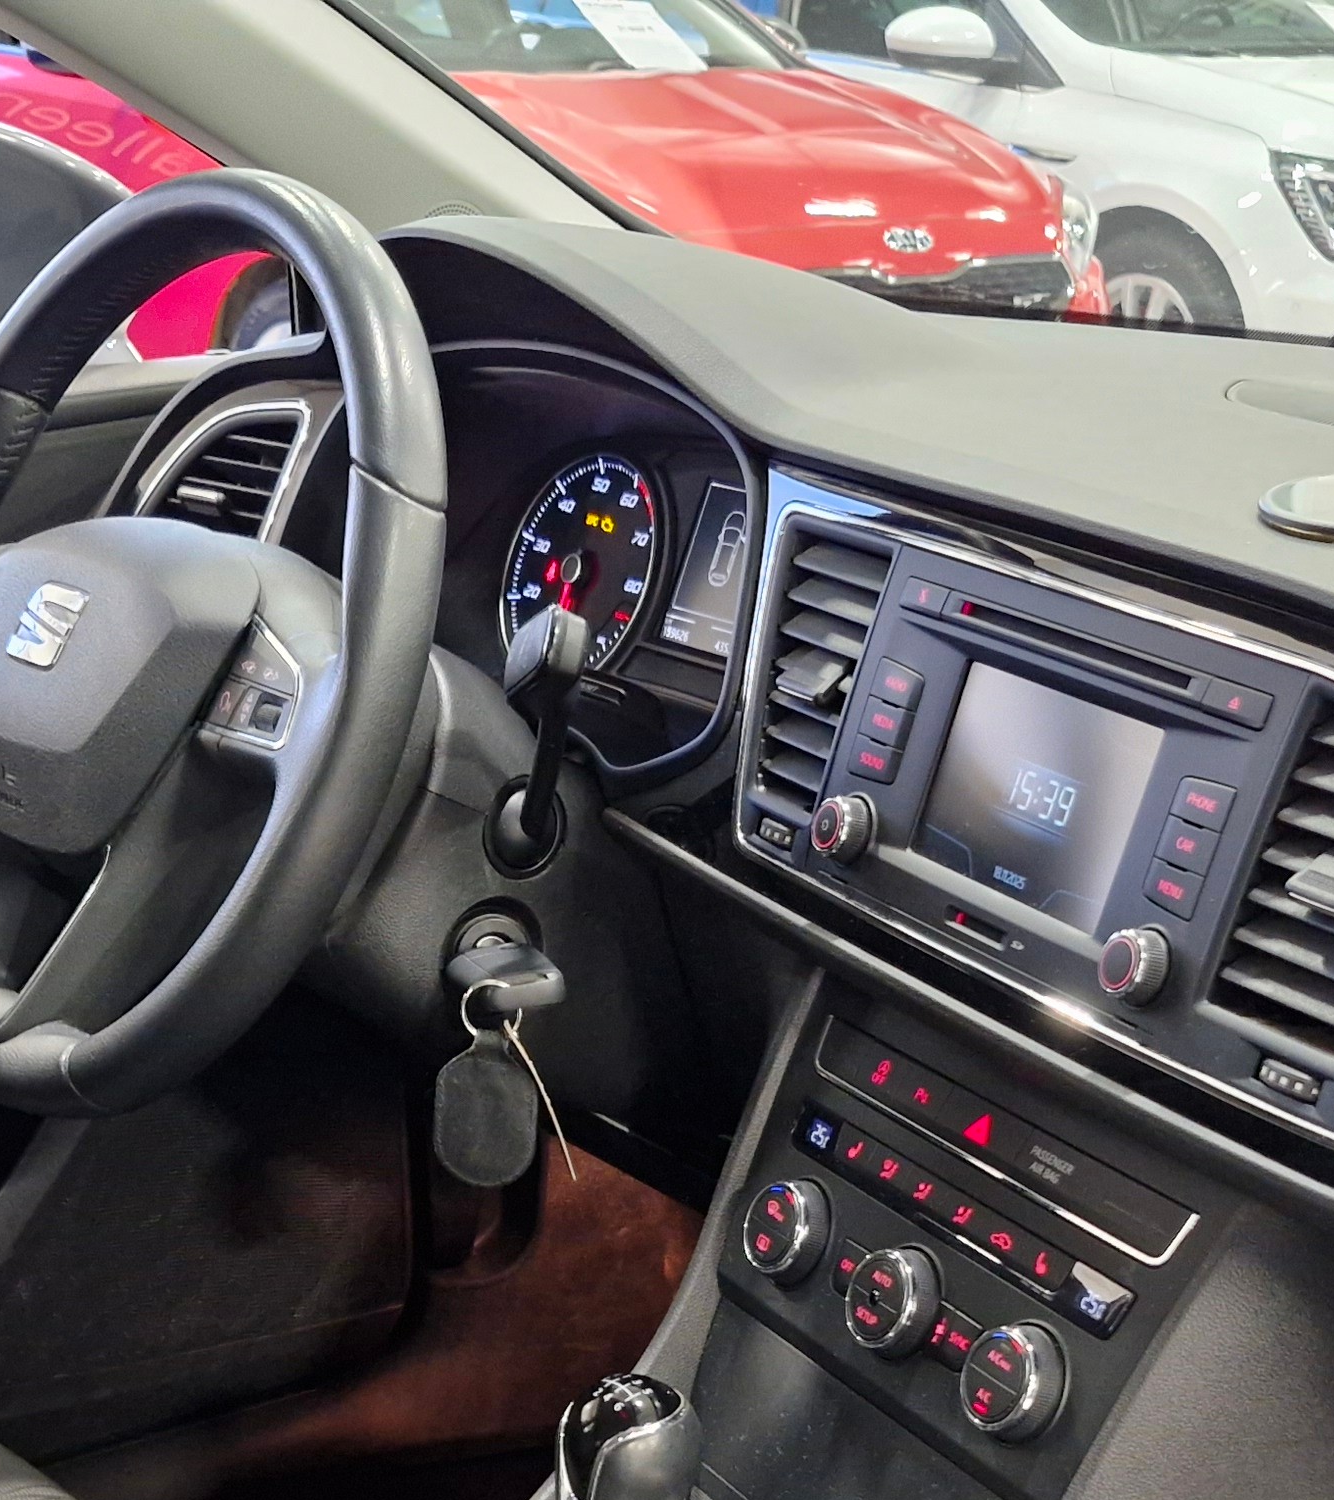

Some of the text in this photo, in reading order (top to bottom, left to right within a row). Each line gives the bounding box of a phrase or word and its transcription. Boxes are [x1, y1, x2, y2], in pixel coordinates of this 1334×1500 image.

[591, 476, 611, 494] 50
[557, 498, 576, 514] 40
[619, 492, 639, 508] 60
[533, 538, 551, 554] 30
[630, 530, 650, 547] 70
[523, 582, 542, 600] 20
[623, 577, 643, 595] 80
[1008, 769, 1077, 827] 15:39
[1030, 1145, 1074, 1176] PASSENGER
[840, 1257, 856, 1273] OFF
[872, 1270, 893, 1288] AUTO
[855, 1305, 879, 1326] SETUP
[613, 1402, 625, 1412] 6
